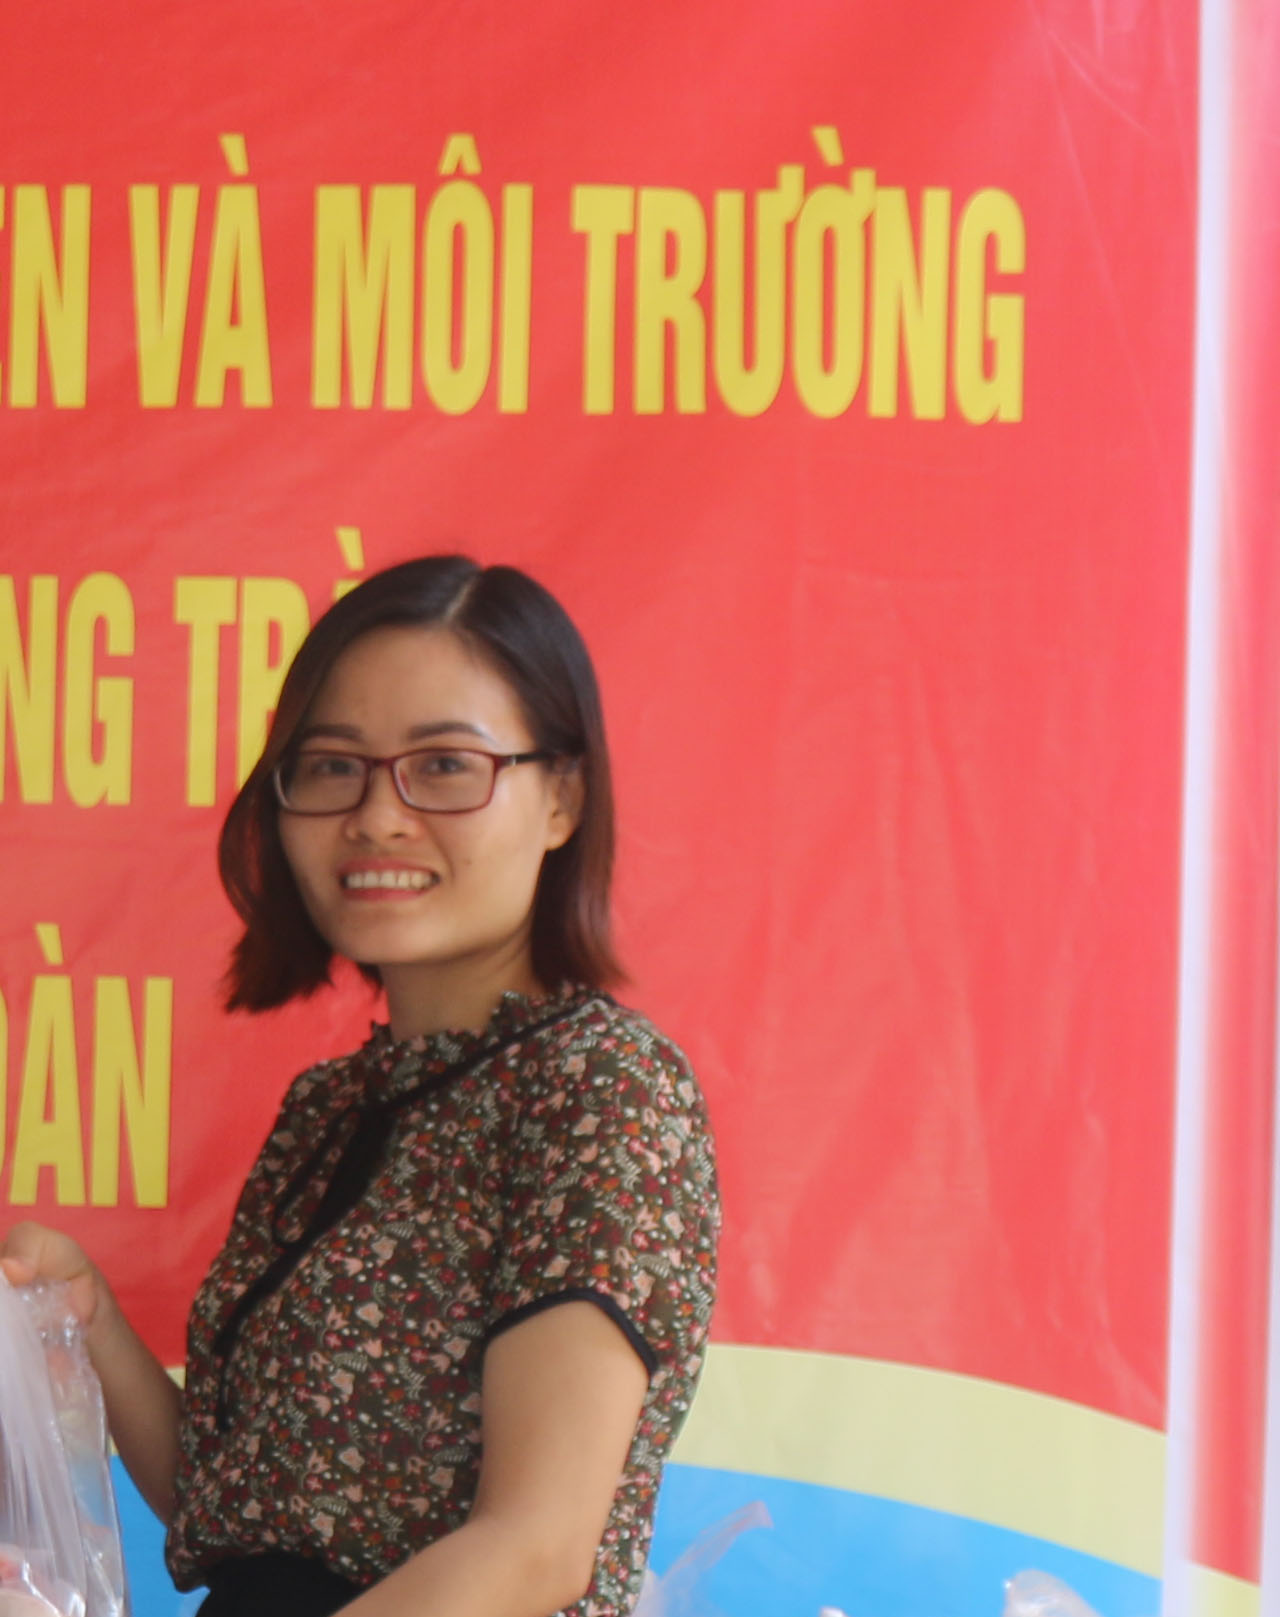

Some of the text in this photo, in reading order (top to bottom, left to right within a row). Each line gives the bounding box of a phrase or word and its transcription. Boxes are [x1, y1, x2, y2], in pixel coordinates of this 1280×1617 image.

[128, 133, 274, 409] VÀ
[311, 133, 536, 414] MÔI
[570, 125, 1027, 424] TRƯỜNG
